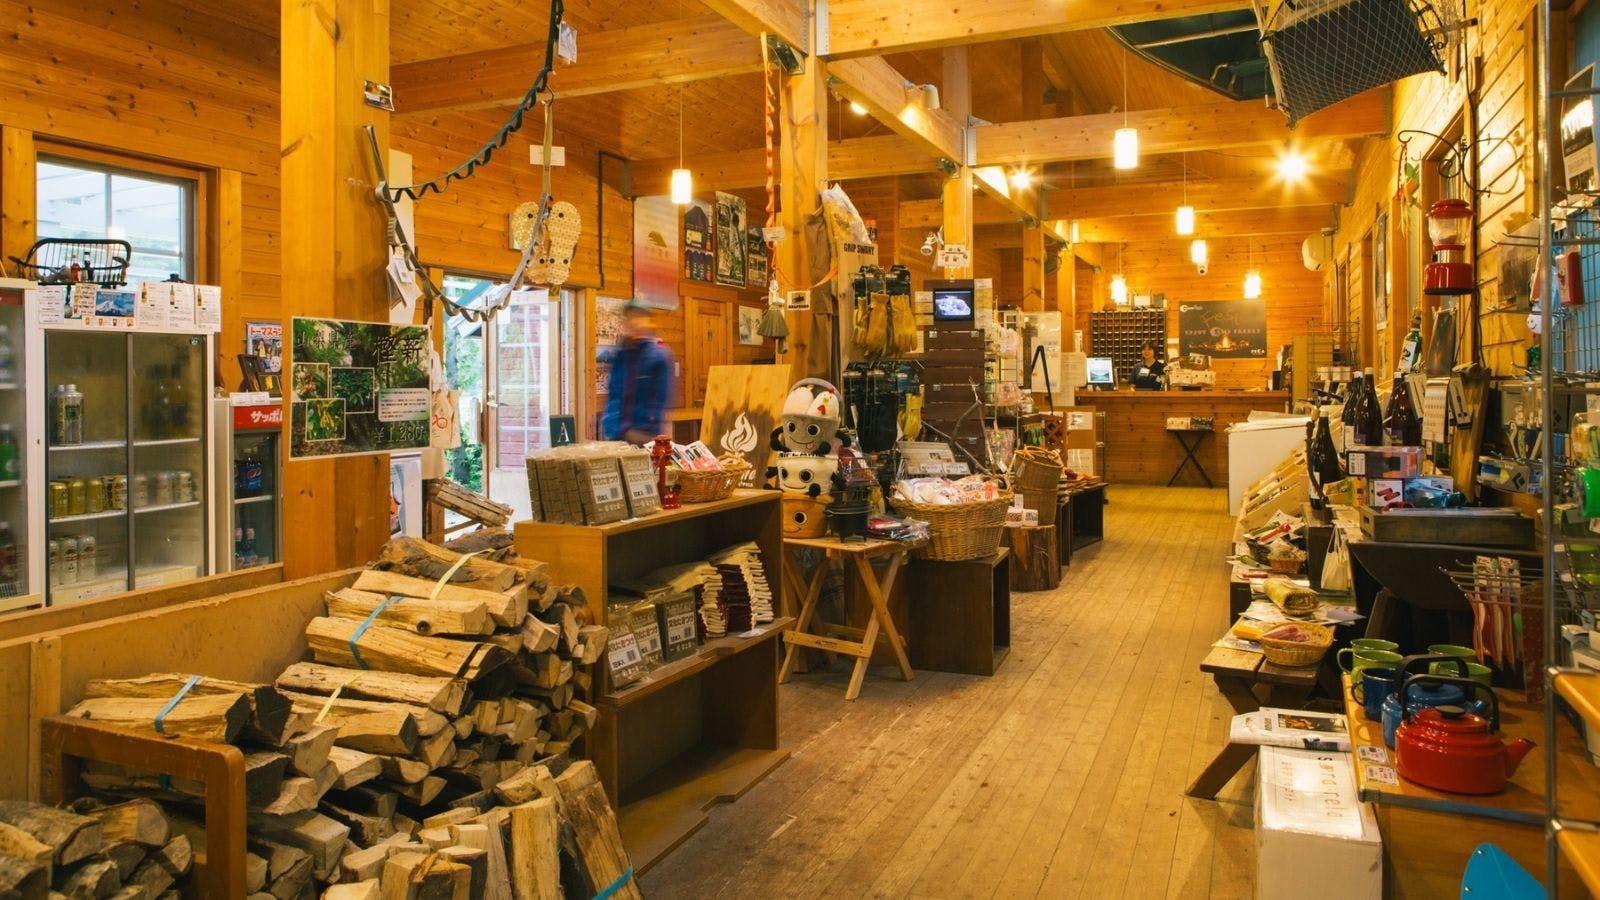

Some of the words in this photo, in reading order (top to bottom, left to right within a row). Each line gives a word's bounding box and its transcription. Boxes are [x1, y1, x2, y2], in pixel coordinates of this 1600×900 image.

[844, 242, 856, 253] GRIP
[250, 409, 282, 424] サッポ
